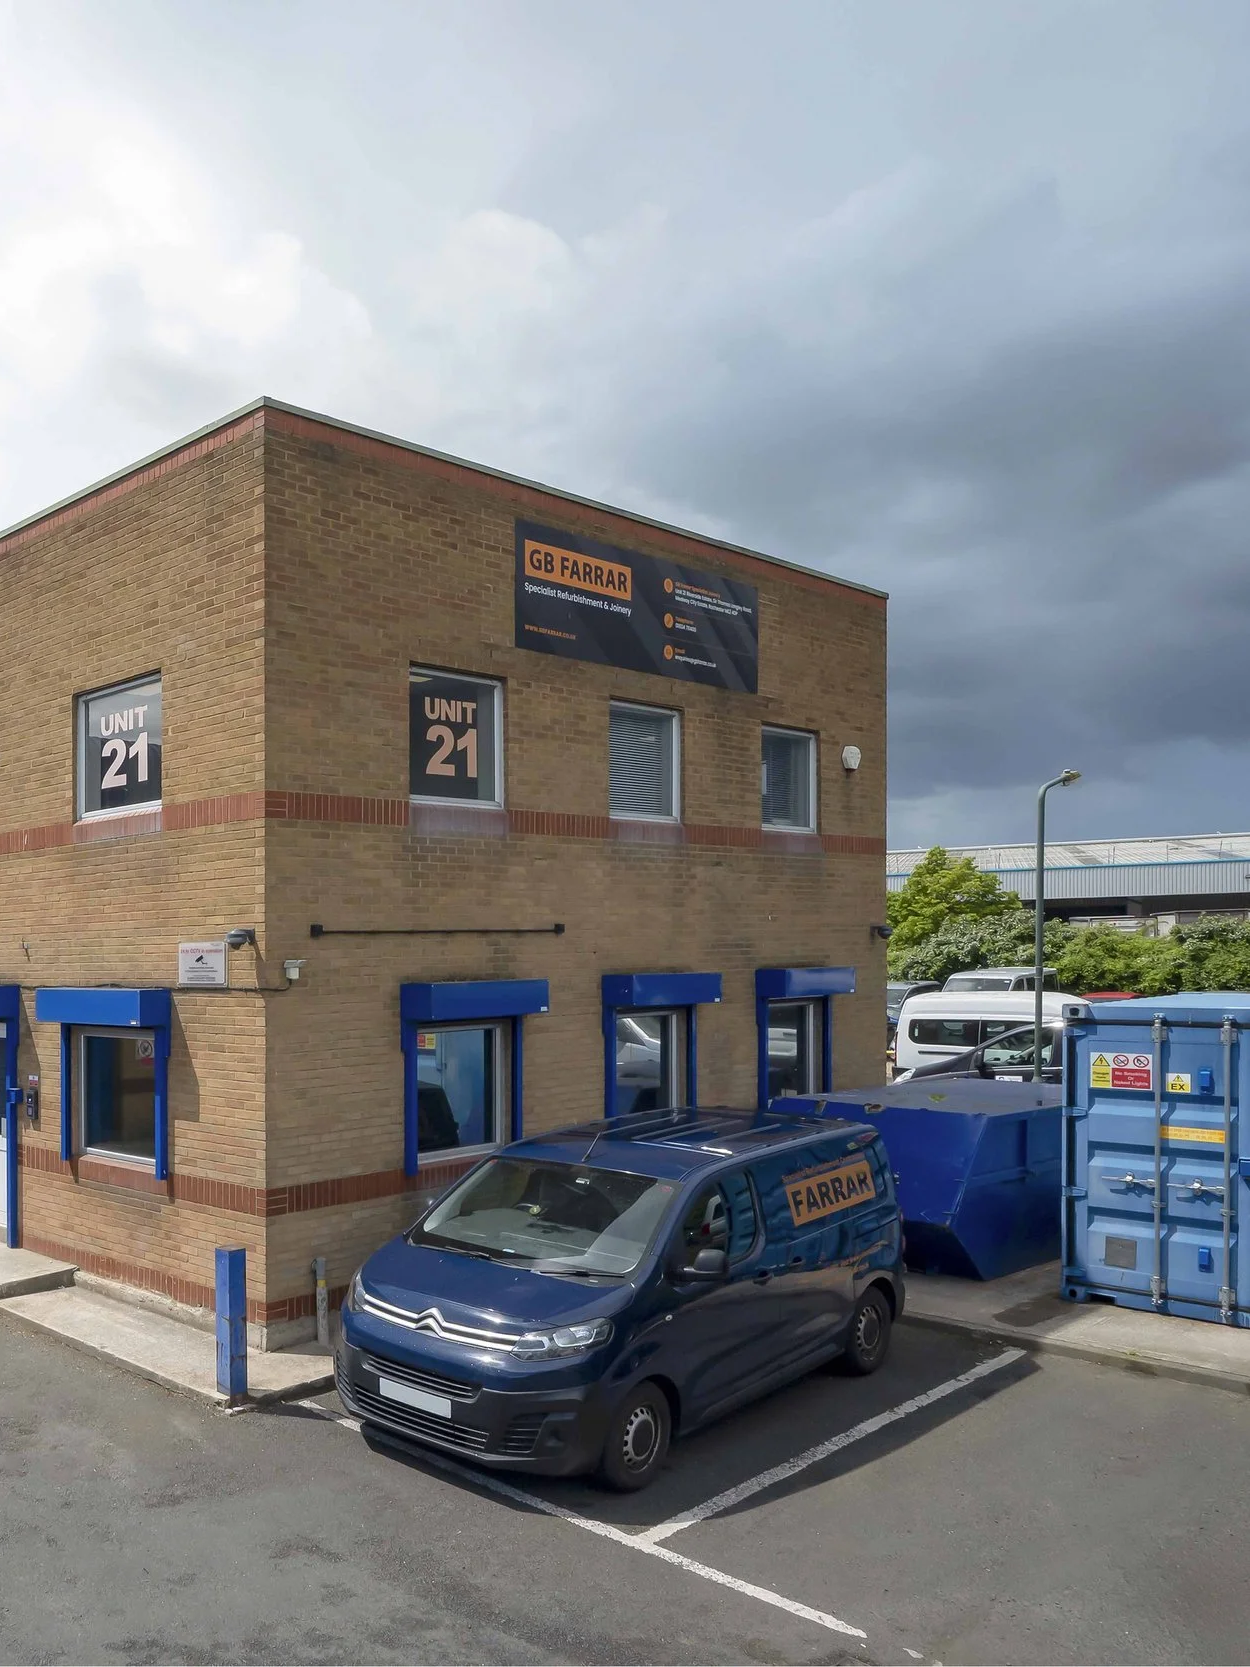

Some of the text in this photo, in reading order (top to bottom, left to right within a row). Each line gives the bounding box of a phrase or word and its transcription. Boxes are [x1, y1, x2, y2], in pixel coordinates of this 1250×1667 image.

[529, 549, 628, 593] GB FARRAR
[524, 582, 632, 617] Specialist Refurbishment & Joinery
[100, 704, 148, 737] UNIT
[424, 696, 477, 724] UNIT
[101, 731, 148, 789] 21
[425, 724, 477, 778] 21
[1171, 1083, 1185, 1091] EX
[790, 1170, 872, 1218] FARRAR
